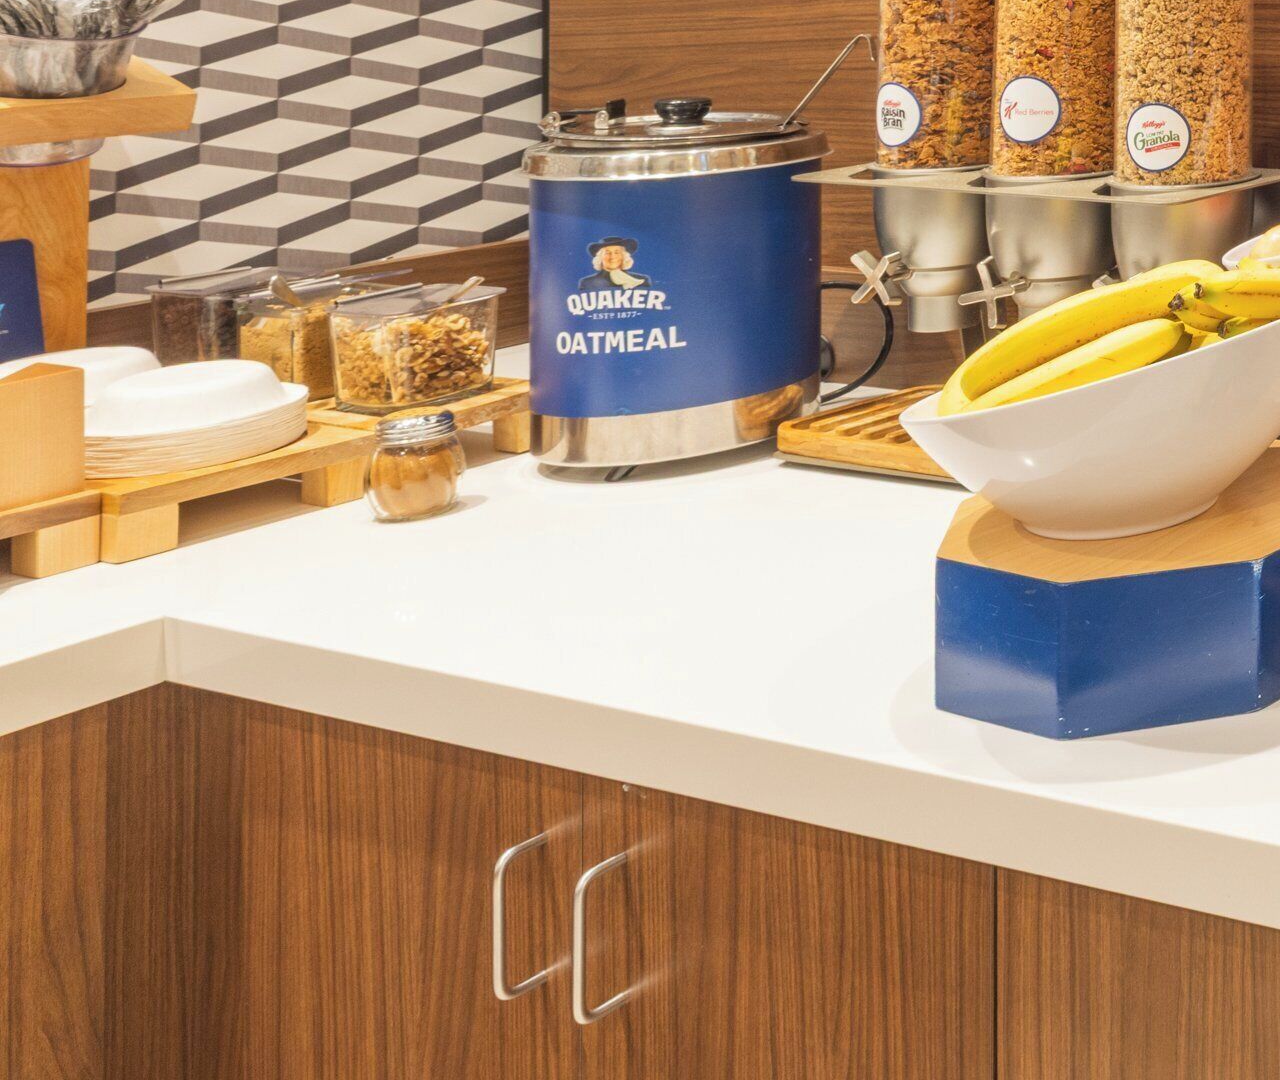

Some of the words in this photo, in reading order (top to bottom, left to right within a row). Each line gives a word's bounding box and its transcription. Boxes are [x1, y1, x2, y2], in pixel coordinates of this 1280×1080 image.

[881, 107, 906, 119] Raisin
[1029, 108, 1054, 116] Berries
[883, 117, 903, 128] Bran
[1133, 130, 1180, 151] Granola
[566, 289, 667, 316] QUAKER
[556, 325, 687, 356] OATMEAL
